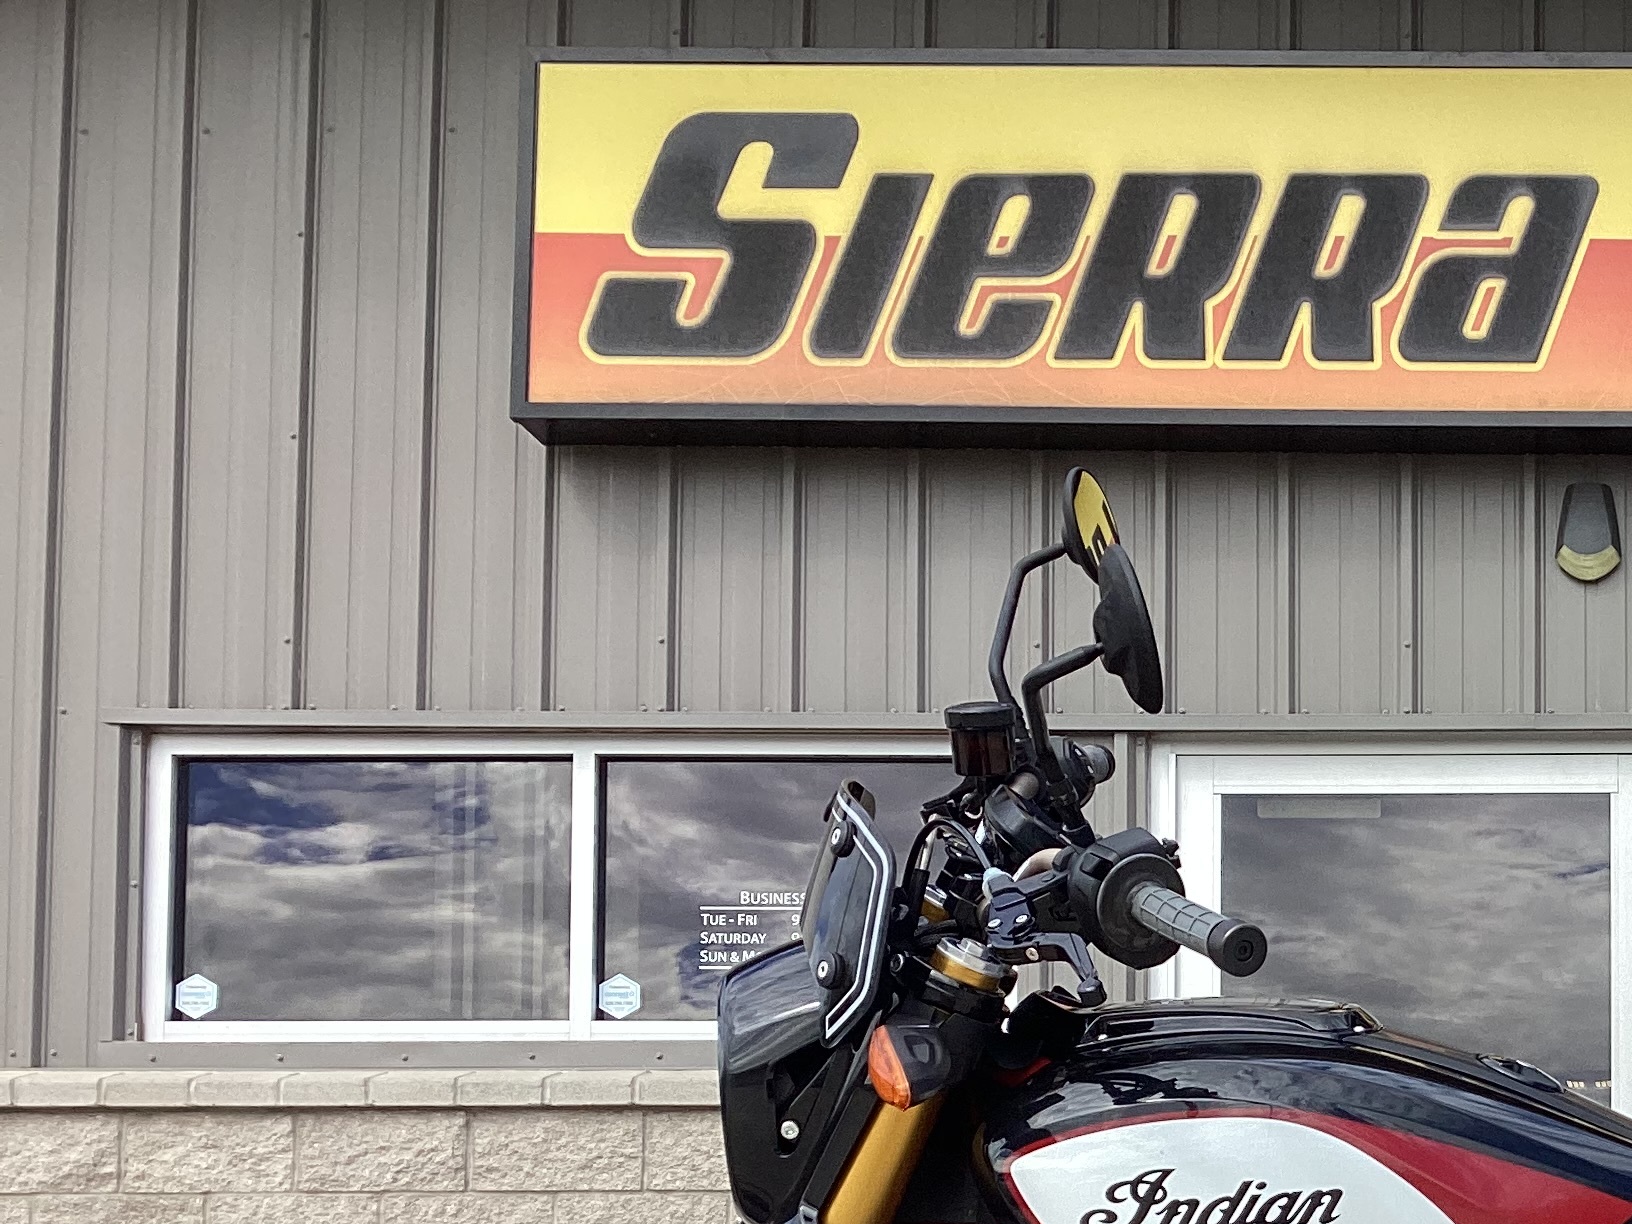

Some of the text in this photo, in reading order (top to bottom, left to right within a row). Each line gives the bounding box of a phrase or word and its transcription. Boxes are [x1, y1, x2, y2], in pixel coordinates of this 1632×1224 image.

[701, 914, 726, 925] TUE
[737, 914, 757, 925] FRI
[700, 932, 767, 944] SATURDAY
[700, 950, 727, 962] SUN
[729, 951, 740, 962] &
